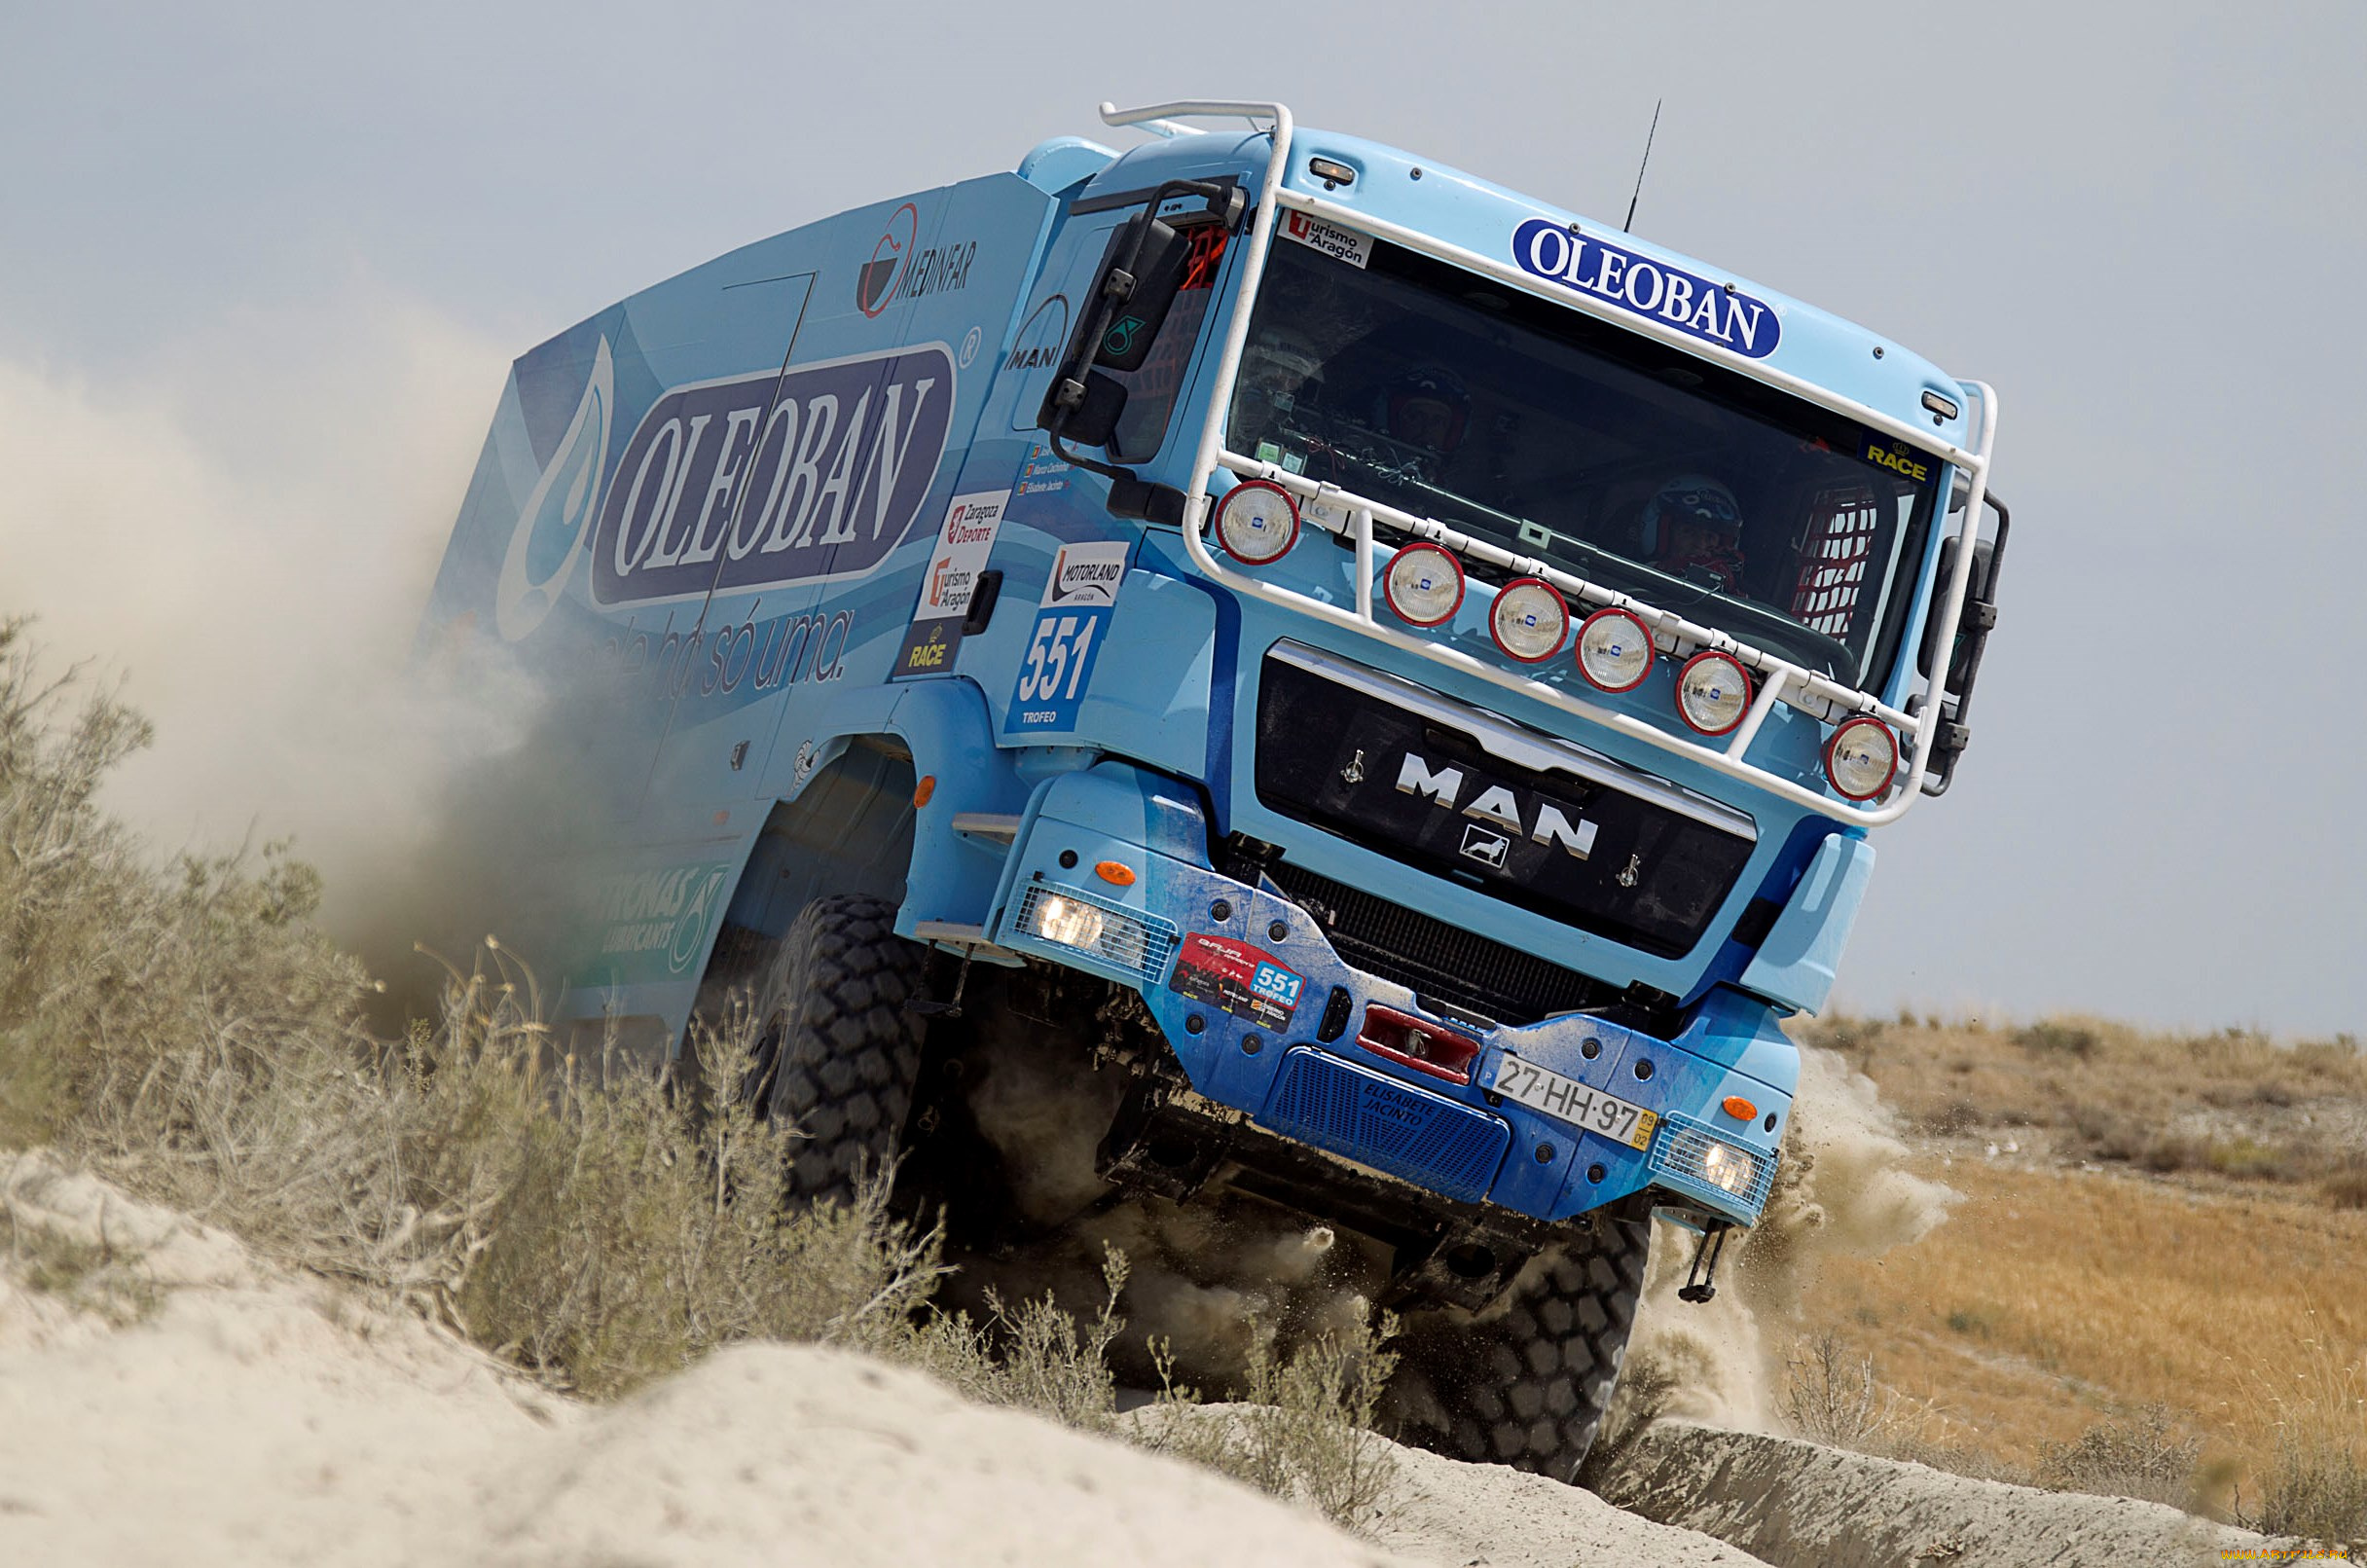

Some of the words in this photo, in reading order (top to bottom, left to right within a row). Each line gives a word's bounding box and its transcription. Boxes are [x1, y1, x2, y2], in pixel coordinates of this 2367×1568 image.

[1289, 208, 1358, 247] Turismo
[1310, 234, 1363, 263] Aragón
[895, 240, 976, 300] MEDINFAR
[1530, 228, 1764, 350] OLEOBAN
[1007, 346, 1056, 371] MAN
[614, 378, 935, 577] OLEOBAN
[1868, 444, 1927, 482] RACE
[964, 503, 1000, 525] Zaragoza
[1062, 564, 1120, 583] MOTORLAND
[701, 597, 761, 698] só
[754, 609, 855, 691] uma.
[908, 643, 946, 668] RACE
[1019, 615, 1098, 702] 551
[1022, 711, 1057, 724] TROFEO
[1395, 752, 1599, 861] MAN
[1253, 983, 1293, 1005] TROFEO
[1257, 966, 1299, 998] 551
[1484, 1072, 1492, 1080] P
[1363, 1098, 1422, 1126] JACINTO
[1364, 1083, 1437, 1116] ELISABETE
[1641, 1112, 1654, 1126] 09
[1633, 1133, 1648, 1146] 02
